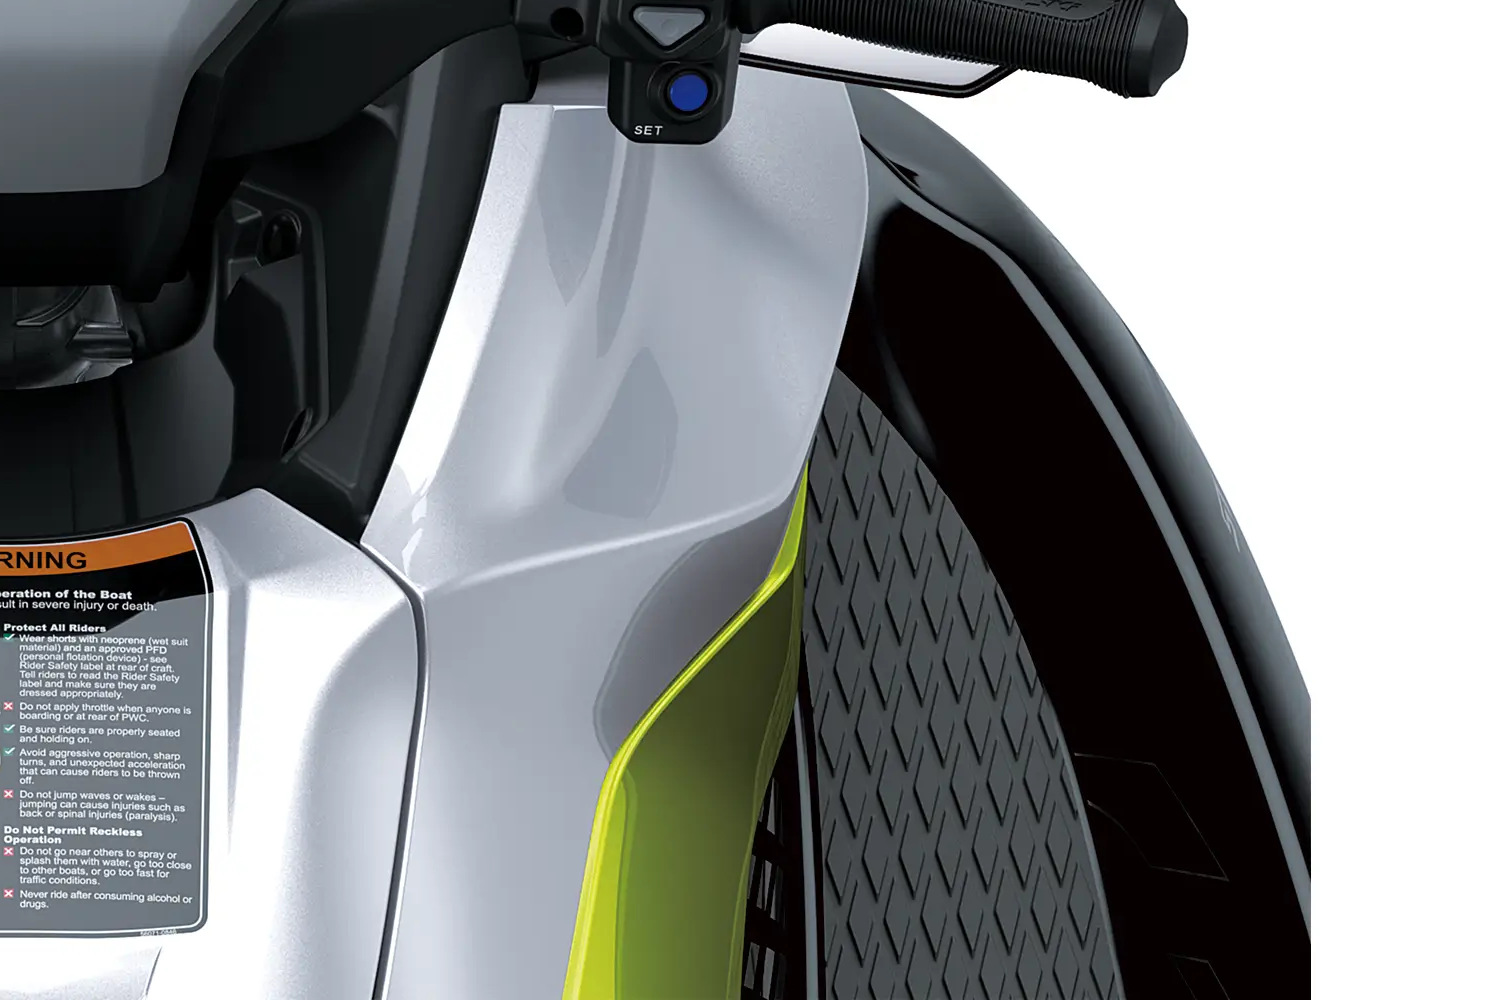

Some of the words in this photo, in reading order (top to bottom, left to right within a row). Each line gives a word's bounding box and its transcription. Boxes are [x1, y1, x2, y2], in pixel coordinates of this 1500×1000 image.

[634, 125, 663, 135] SET
[55, 589, 69, 599] of
[74, 589, 96, 599] the
[100, 589, 132, 599] Boat
[19, 600, 29, 609] in
[74, 600, 104, 612] injury
[122, 601, 157, 611] death.
[4, 623, 47, 632] Protect
[50, 624, 66, 632] All
[69, 624, 106, 632] Riders
[19, 702, 34, 710] Do
[36, 702, 51, 711] not
[53, 703, 80, 714] apply
[82, 704, 115, 712] throttle
[117, 705, 143, 713] when
[146, 707, 181, 716] anyone
[183, 706, 192, 714] is
[19, 711, 62, 722] boarding
[76, 712, 86, 720] at
[109, 713, 119, 721] of
[121, 713, 150, 722] PWC.
[4, 826, 20, 834] Do
[23, 826, 44, 834] Not
[47, 826, 86, 835] Permit
[90, 827, 143, 836] Reckless
[4, 835, 62, 846] Operation
[20, 890, 48, 899] Never
[50, 891, 68, 900] ride
[70, 892, 91, 900] after
[94, 892, 145, 904] consuming
[147, 894, 181, 903] alcohol
[20, 900, 49, 910] drugs.
